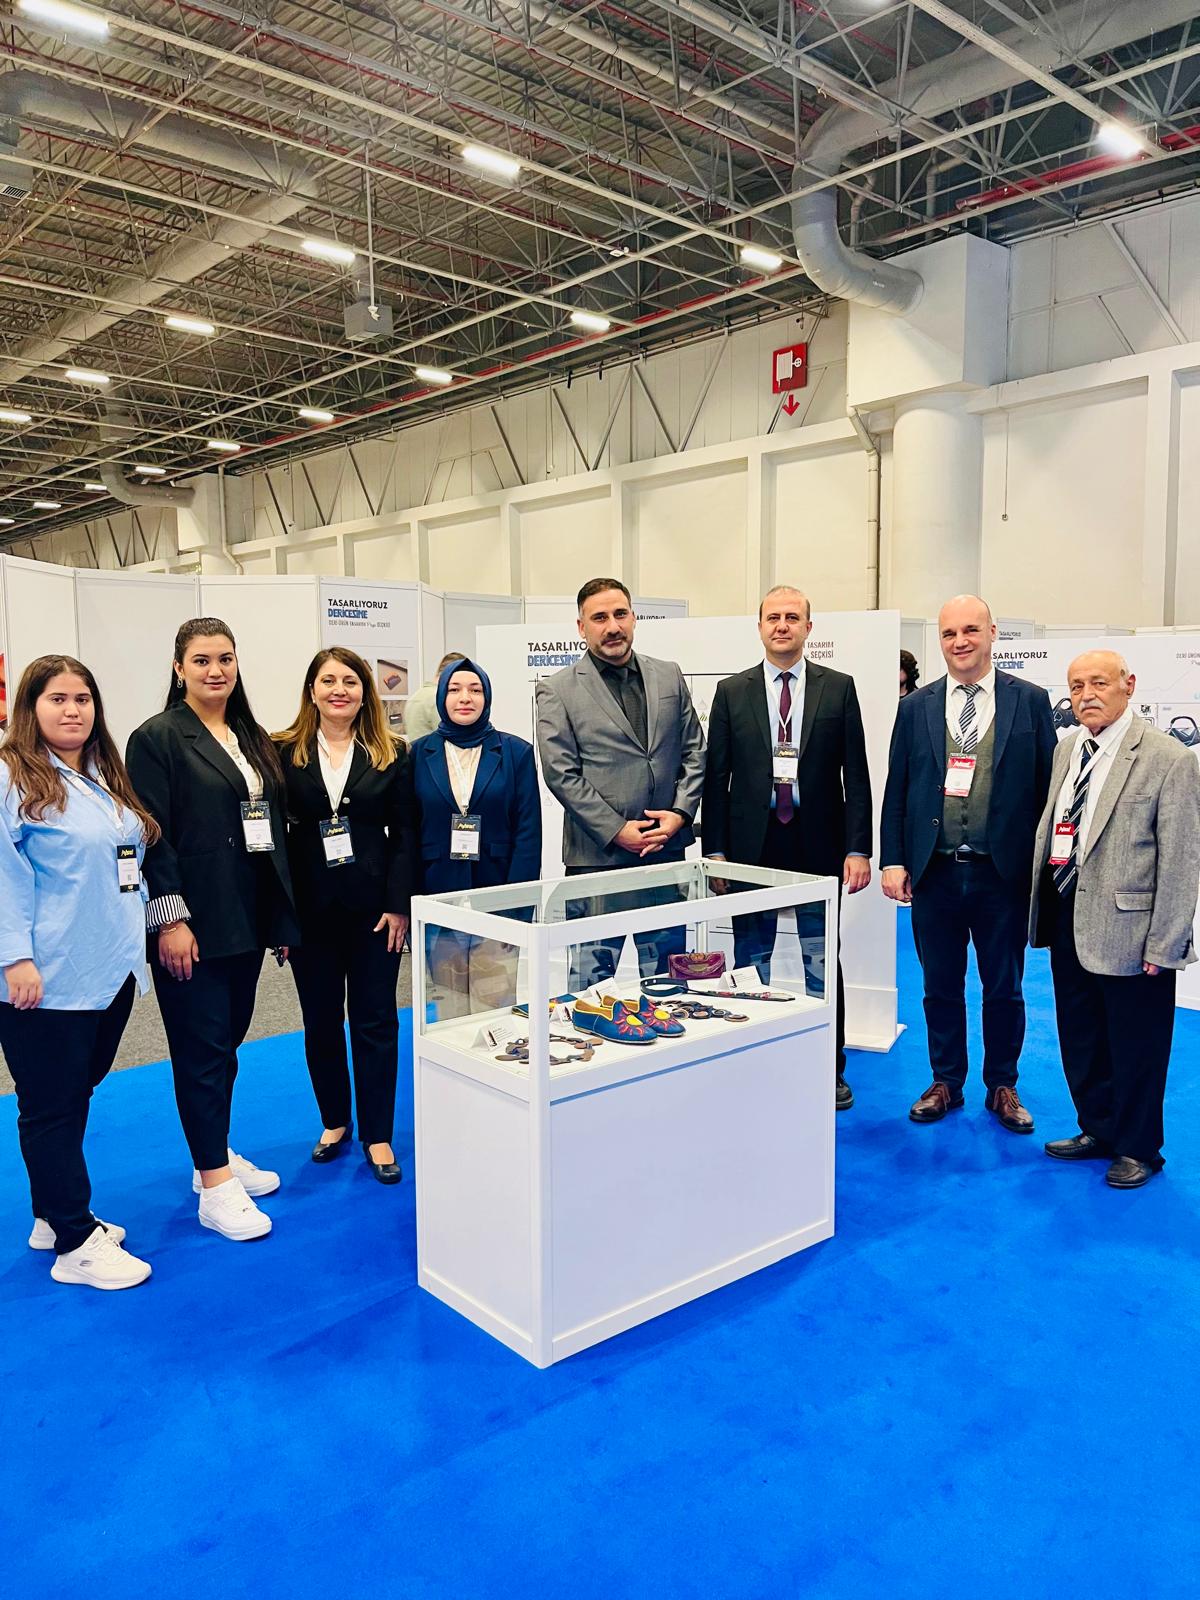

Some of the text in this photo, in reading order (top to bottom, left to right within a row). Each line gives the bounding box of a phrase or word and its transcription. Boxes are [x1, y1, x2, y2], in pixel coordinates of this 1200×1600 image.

[328, 598, 388, 609] TASARLIYORUZ
[528, 641, 588, 652] TASARLIYO
[807, 641, 834, 649] TASARIM
[810, 650, 834, 660] SEÇKİSİ
[992, 651, 1048, 660] SARLIYORUZ
